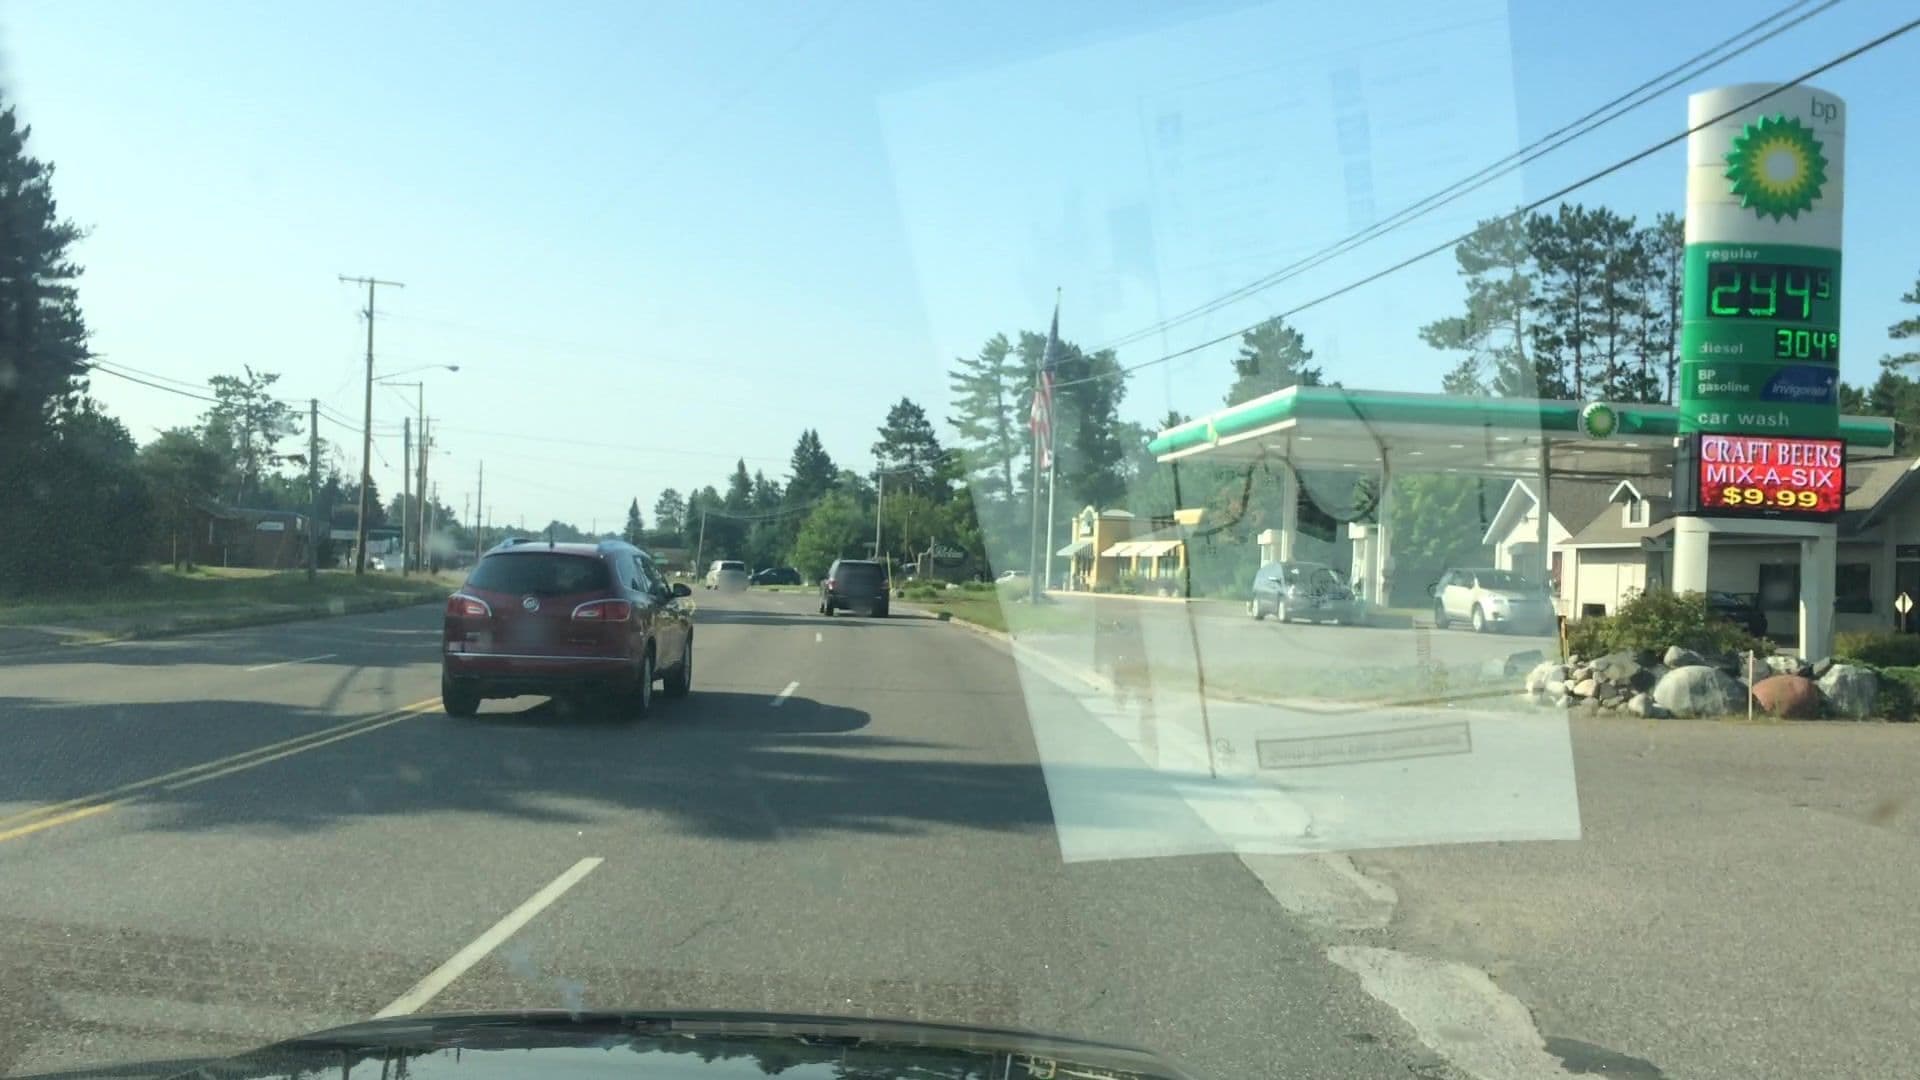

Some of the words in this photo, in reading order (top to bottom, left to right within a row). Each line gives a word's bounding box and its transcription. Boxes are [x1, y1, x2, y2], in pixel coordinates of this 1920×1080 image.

[1810, 96, 1837, 124] bp
[1705, 247, 1760, 262] regular
[1700, 341, 1744, 354] diesel
[1698, 369, 1716, 381] BP
[1698, 381, 1750, 394] gasoline
[1698, 412, 1730, 425] car
[1737, 411, 1790, 427] wash
[1702, 439, 1772, 465] CRAFT
[1777, 442, 1841, 468] BEERS
[1706, 464, 1834, 488] MIX-A-SIX
[1722, 485, 1818, 508] $9.99
